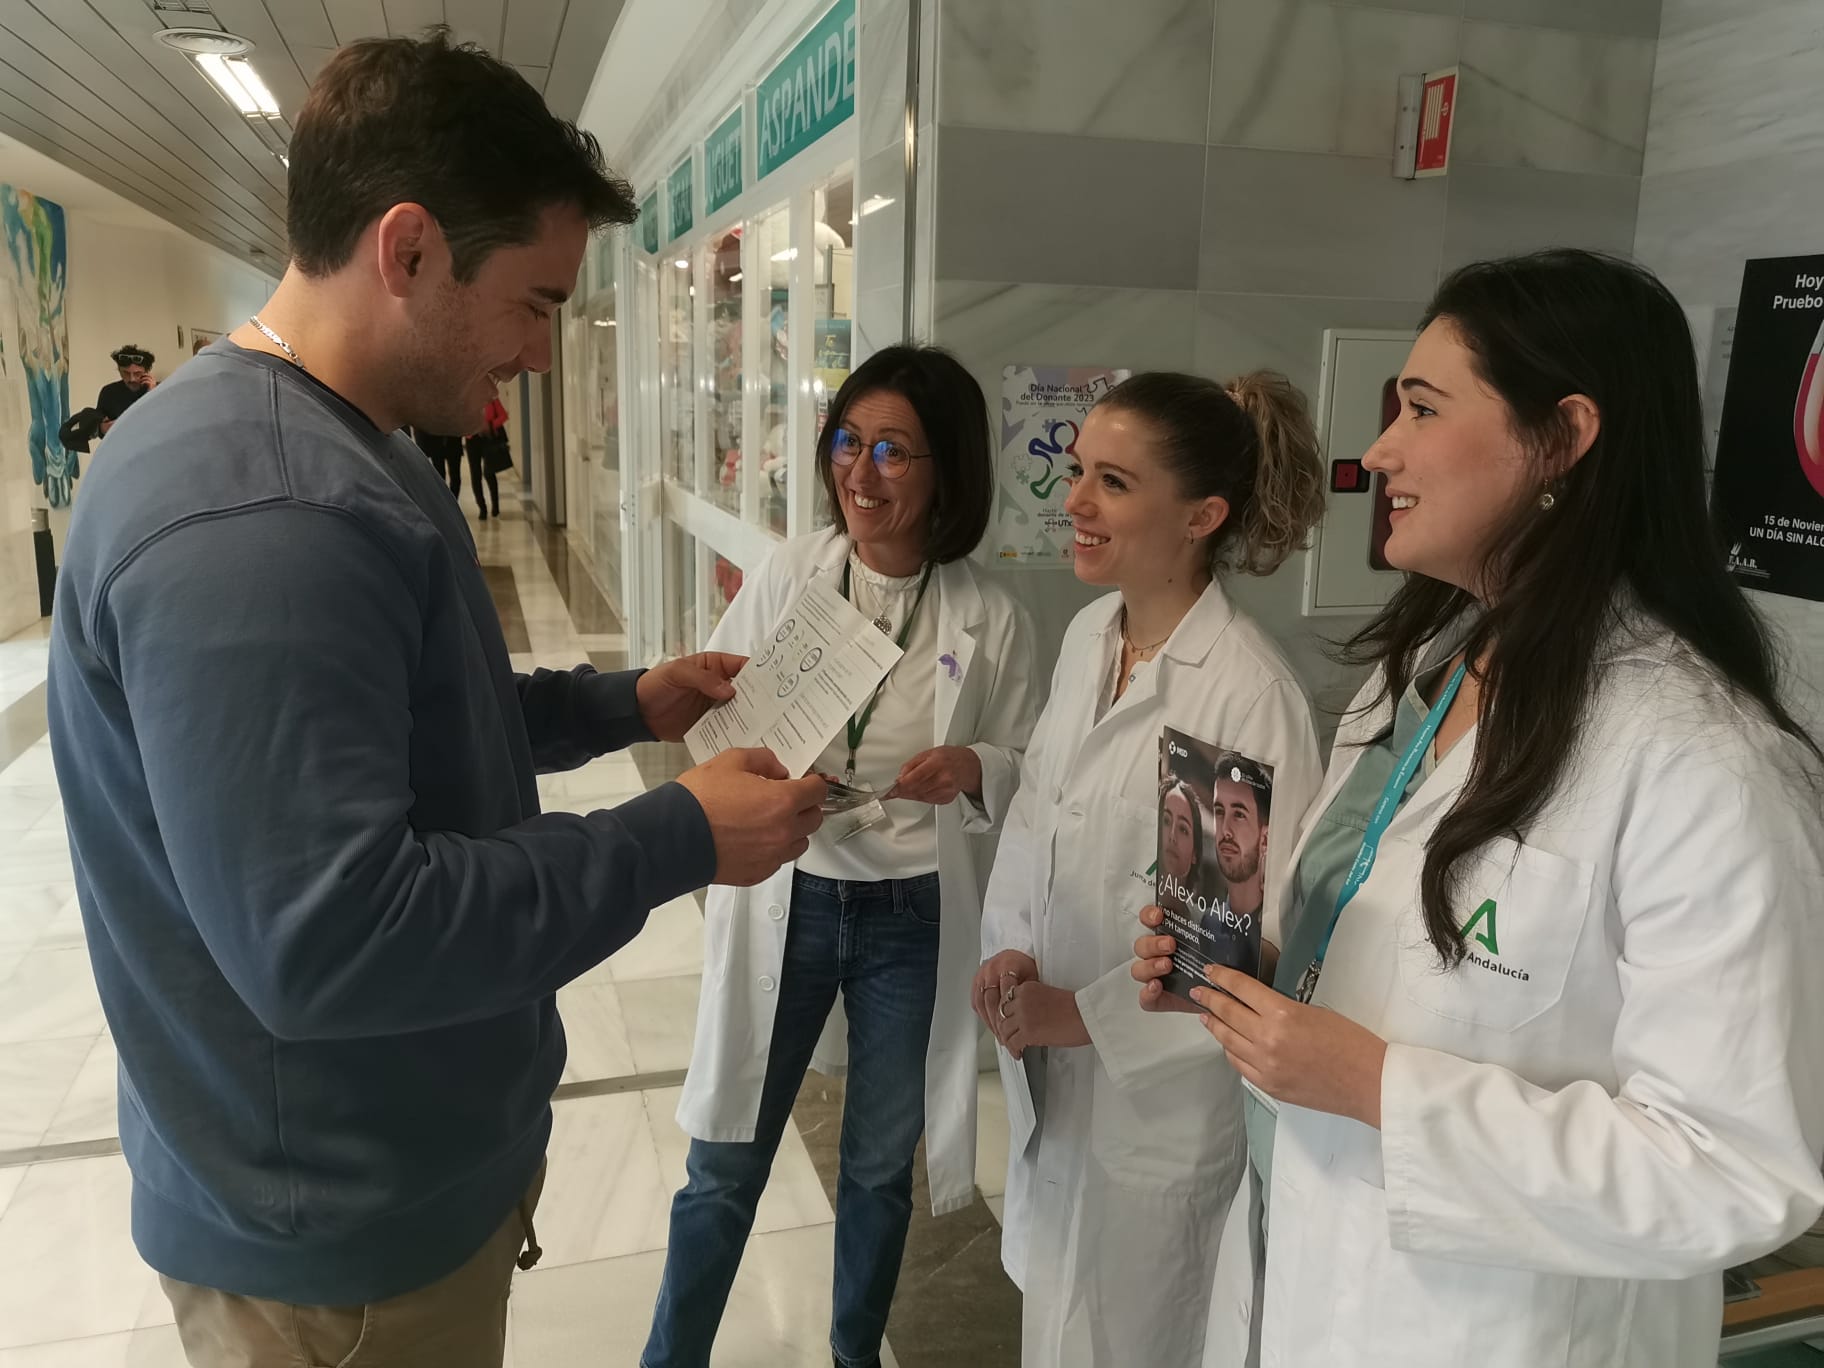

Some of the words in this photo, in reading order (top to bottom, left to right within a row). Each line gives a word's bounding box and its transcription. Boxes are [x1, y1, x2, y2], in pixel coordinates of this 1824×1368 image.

[1795, 274, 1824, 291] Hoy
[1773, 294, 1824, 310] Pruebo
[1030, 383, 1045, 393] Día
[1046, 384, 1083, 394] Nacional
[1020, 393, 1034, 401] del
[1036, 393, 1072, 402] Donante
[1073, 394, 1095, 403] 2023
[1764, 515, 1776, 526] 15
[1777, 517, 1790, 528] de
[1749, 527, 1764, 539] UN
[1766, 528, 1784, 542] DÍA
[1786, 532, 1804, 545] SIN
[1158, 873, 1195, 907] ¿Alex
[1198, 896, 1207, 912] o
[1210, 897, 1252, 938] Alex?
[1171, 910, 1187, 926] haces
[1174, 924, 1200, 945] tampoco.
[1466, 951, 1530, 982] Andalucía
